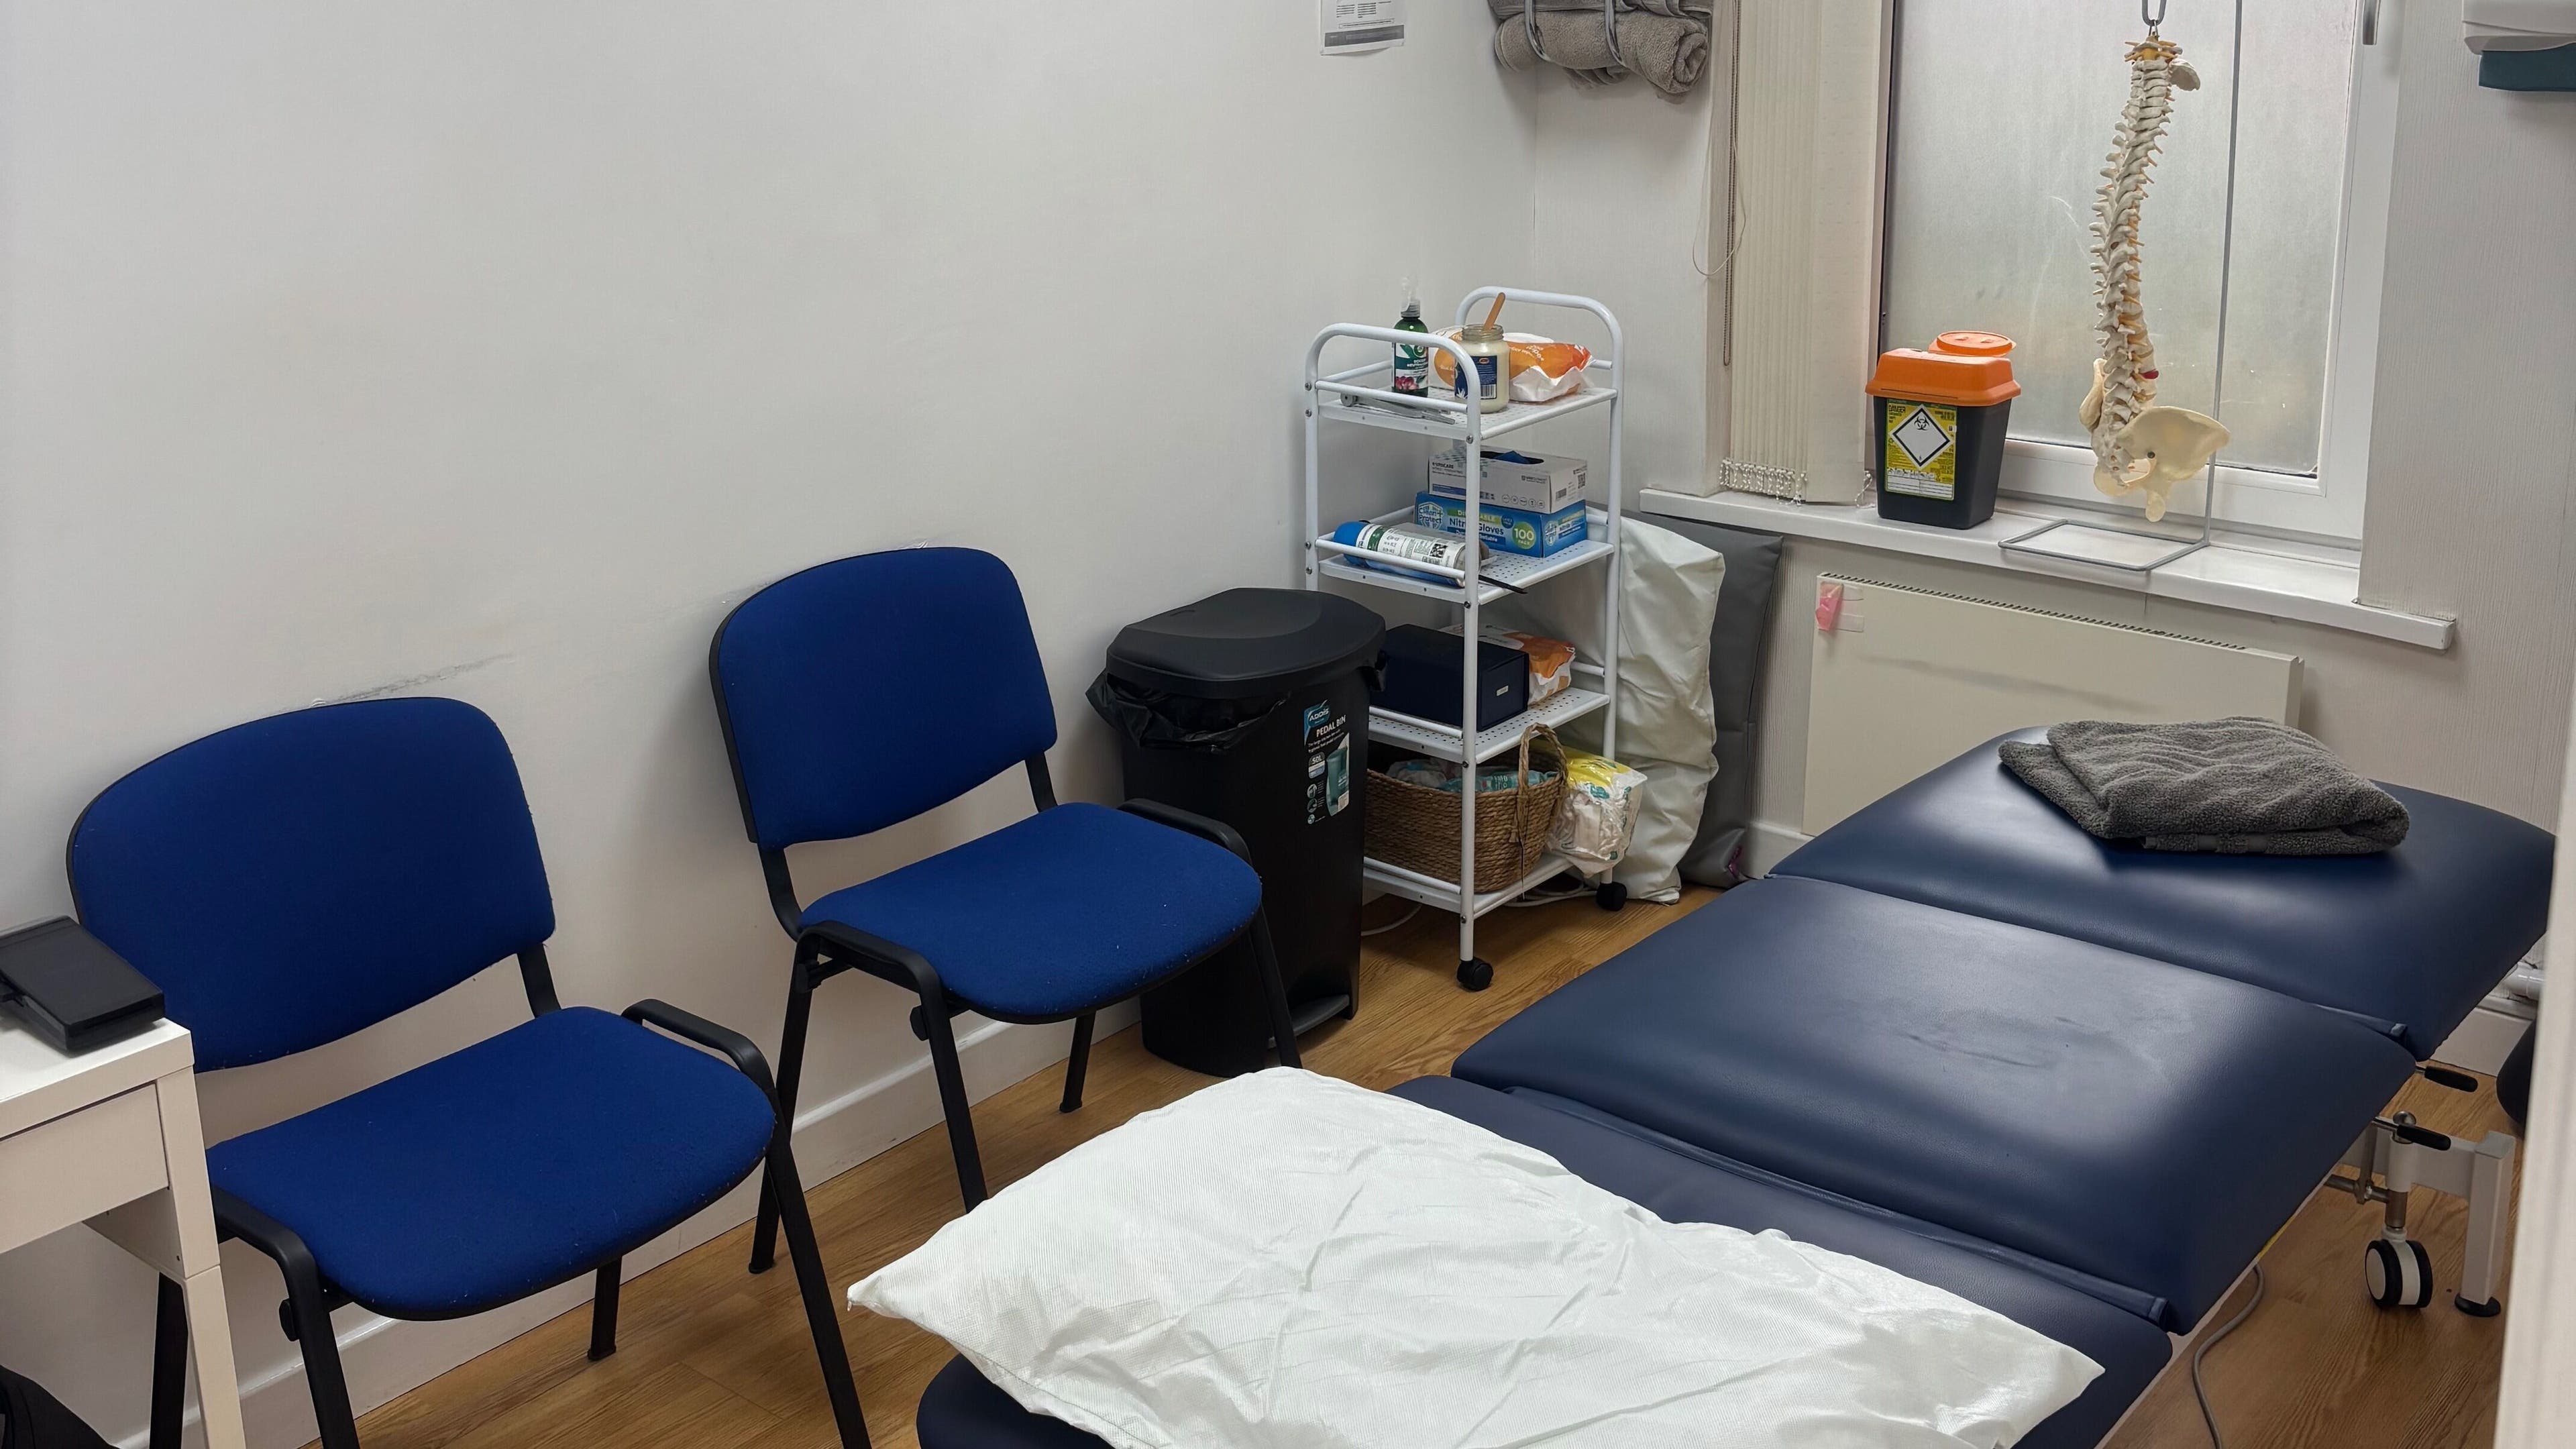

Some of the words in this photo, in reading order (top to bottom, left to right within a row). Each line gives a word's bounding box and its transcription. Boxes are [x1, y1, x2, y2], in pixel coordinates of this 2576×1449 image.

[1419, 515, 1442, 524] Protect
[1514, 528, 1535, 541] 100
[1316, 721, 1336, 737] PEDAL
[1336, 714, 1346, 727] BIN
